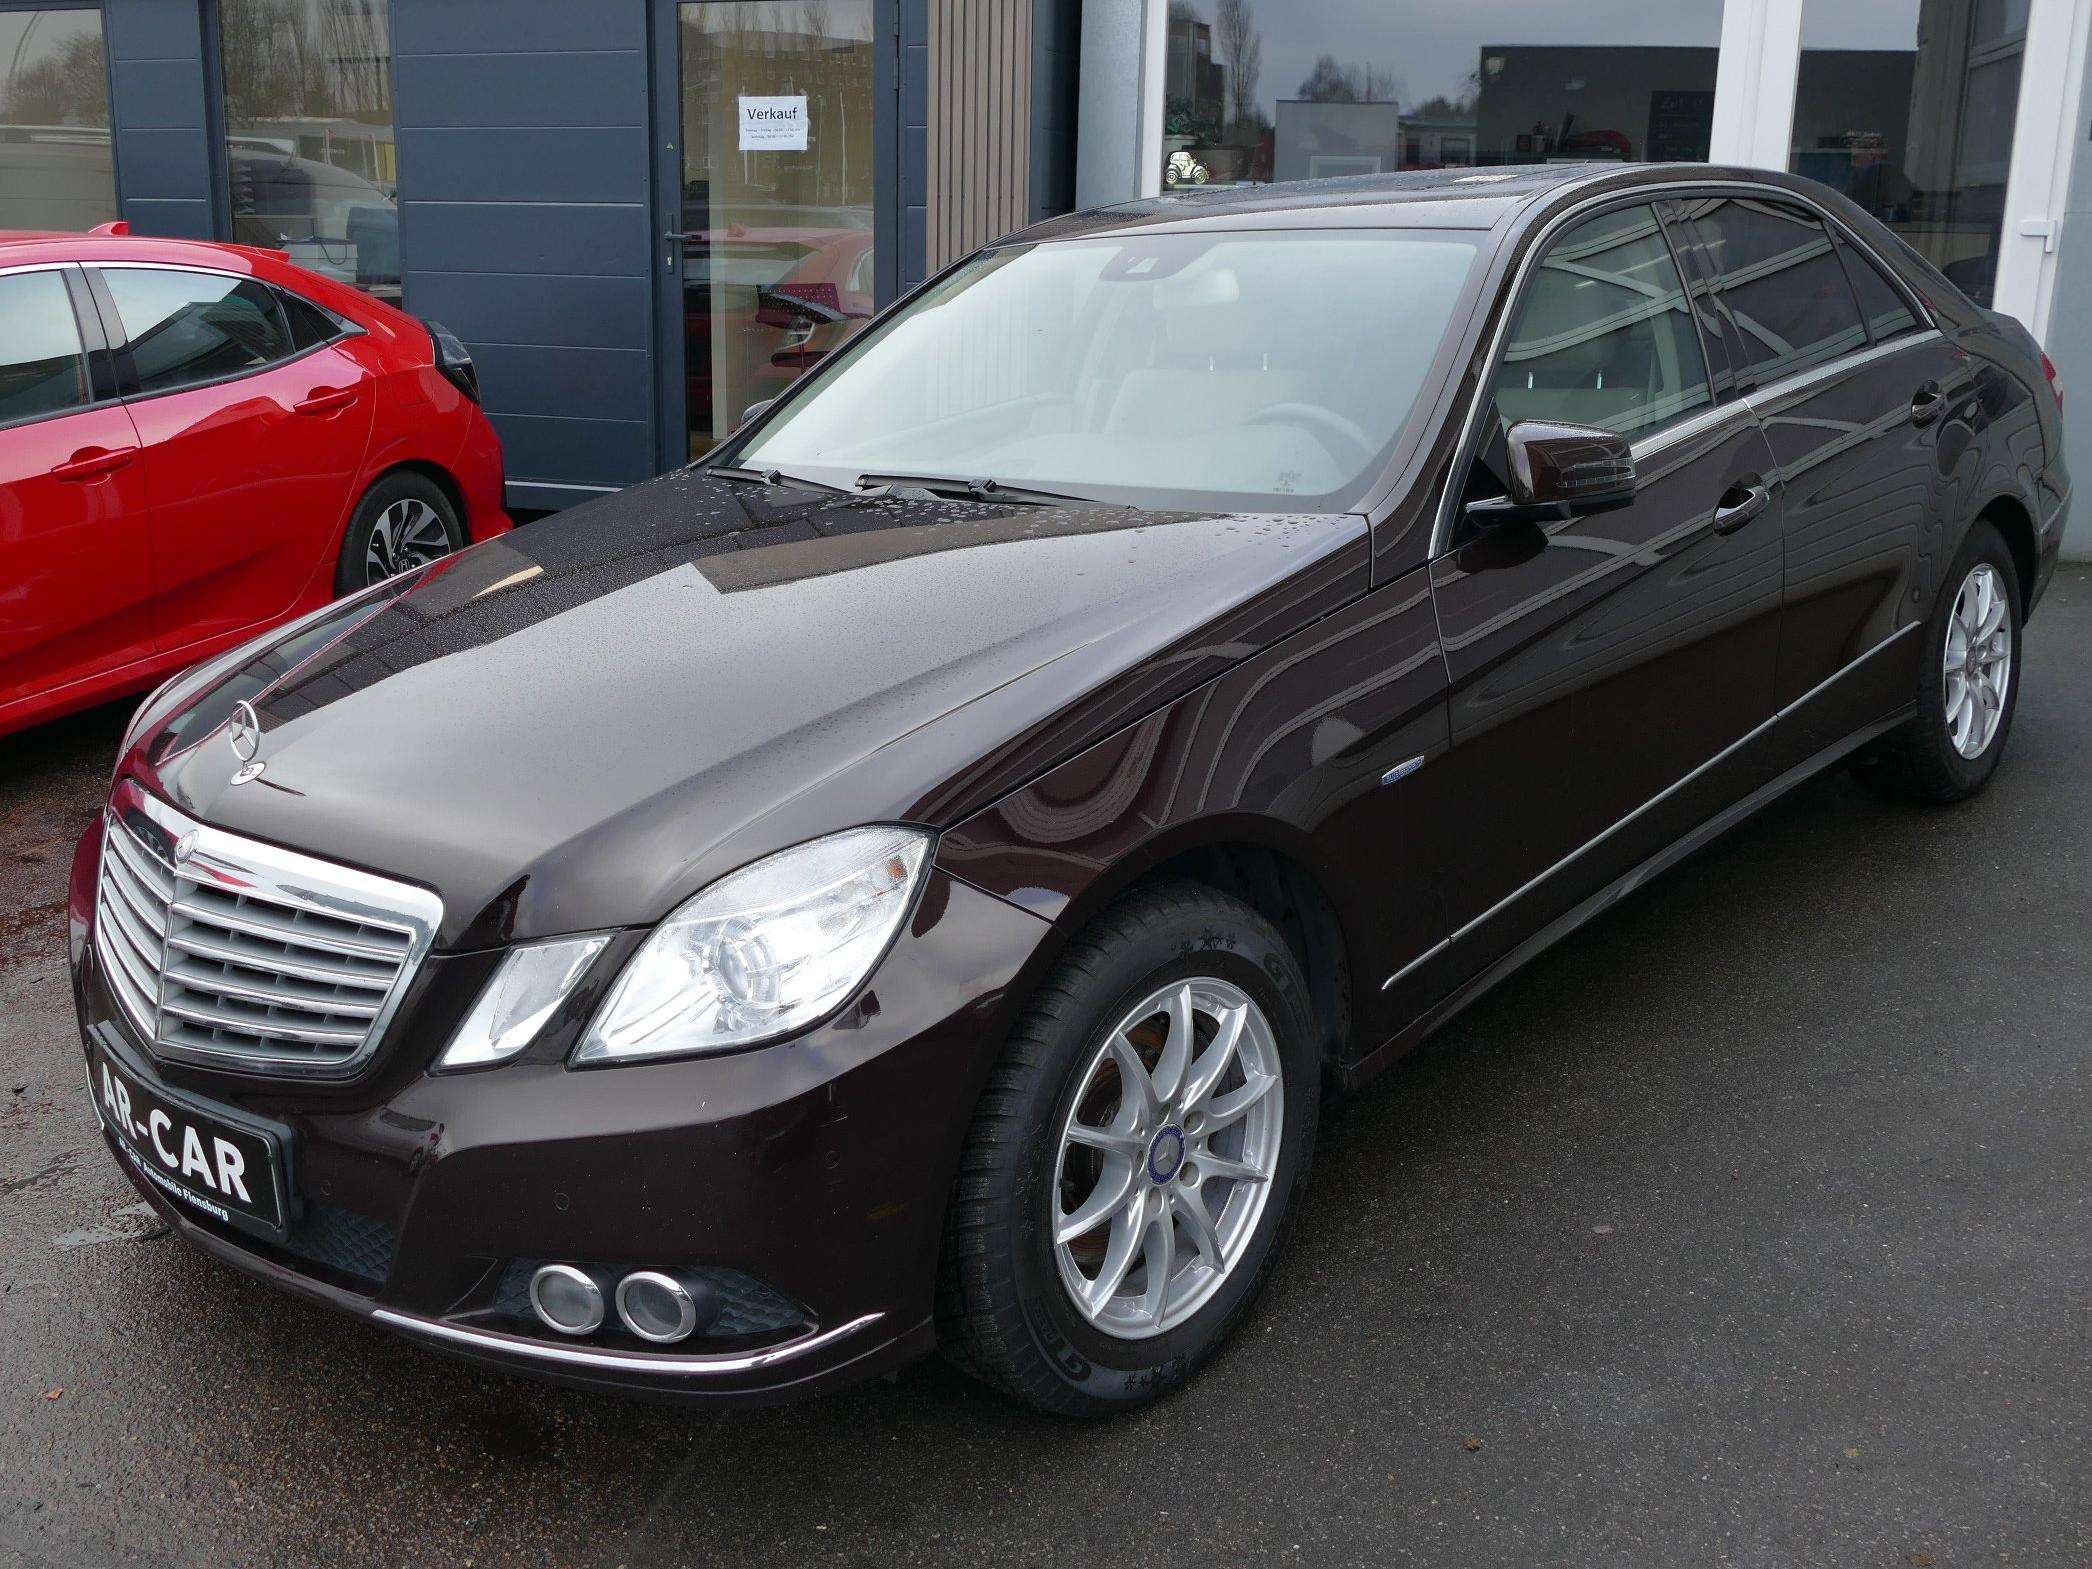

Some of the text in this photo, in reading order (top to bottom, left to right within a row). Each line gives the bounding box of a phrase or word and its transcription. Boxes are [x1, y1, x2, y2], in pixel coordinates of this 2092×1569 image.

[747, 107, 797, 119] Verkauf
[102, 1061, 252, 1203] AR-CAR
[143, 1162, 182, 1196] Automobile
[182, 1188, 228, 1221] Flensburg
